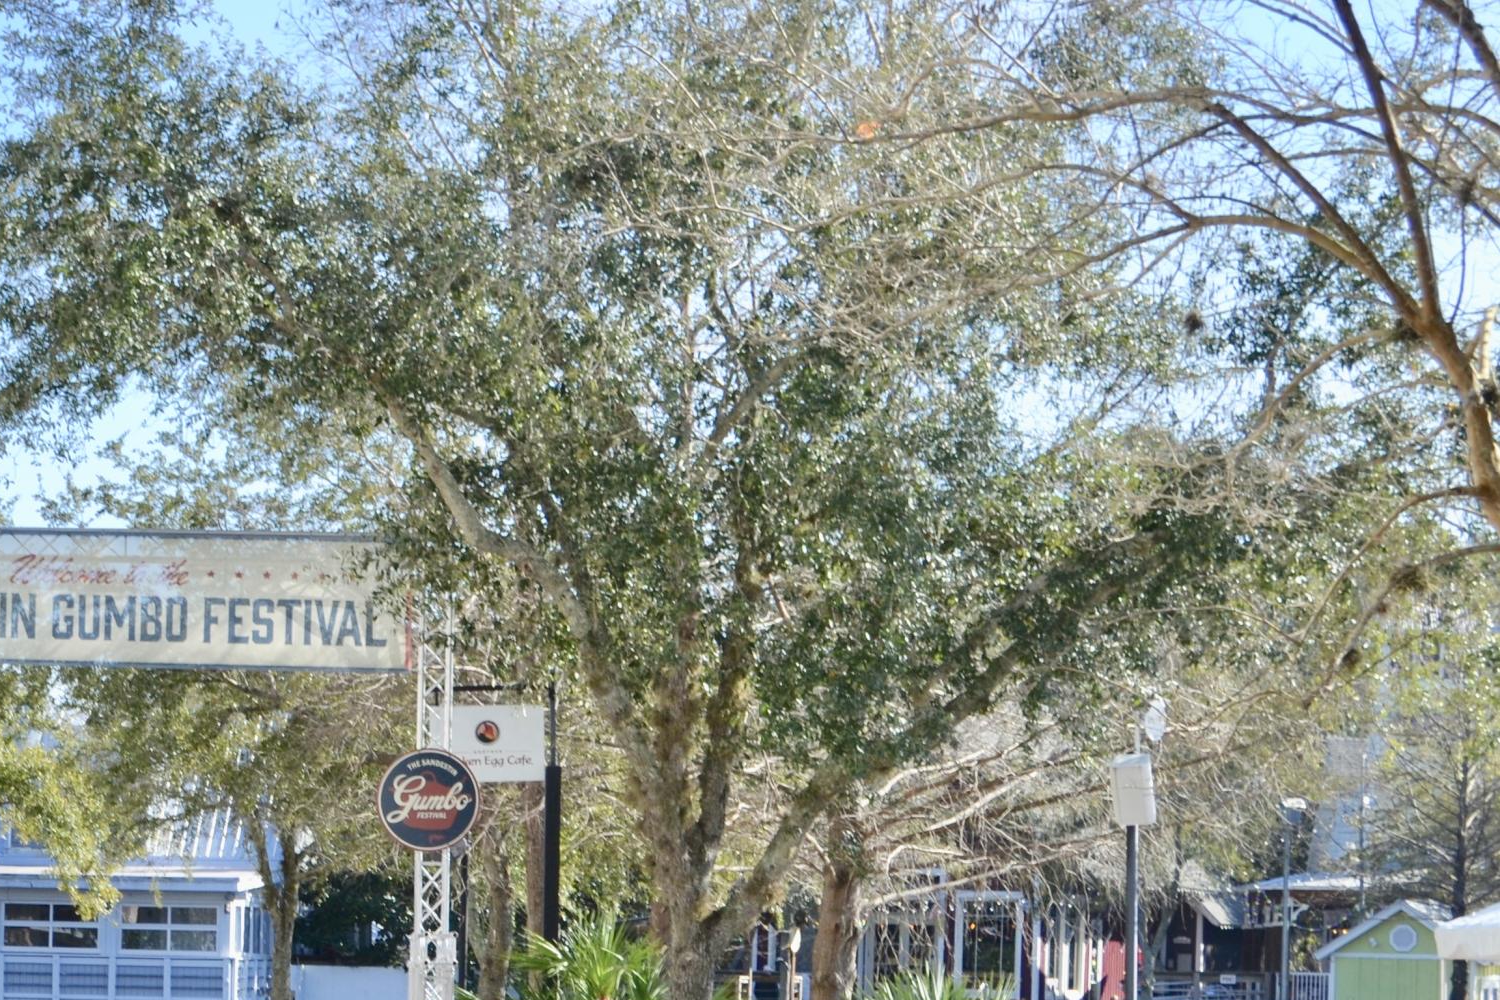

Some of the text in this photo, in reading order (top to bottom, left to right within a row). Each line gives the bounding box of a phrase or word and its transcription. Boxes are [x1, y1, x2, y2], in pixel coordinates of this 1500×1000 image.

[52, 593, 188, 642] GUMBO
[203, 597, 388, 647] FESTIVAL
[406, 760, 421, 771] THE
[484, 755, 504, 767] Egg
[386, 774, 473, 824] Gumbo
[416, 811, 447, 819] FESTIVAL
